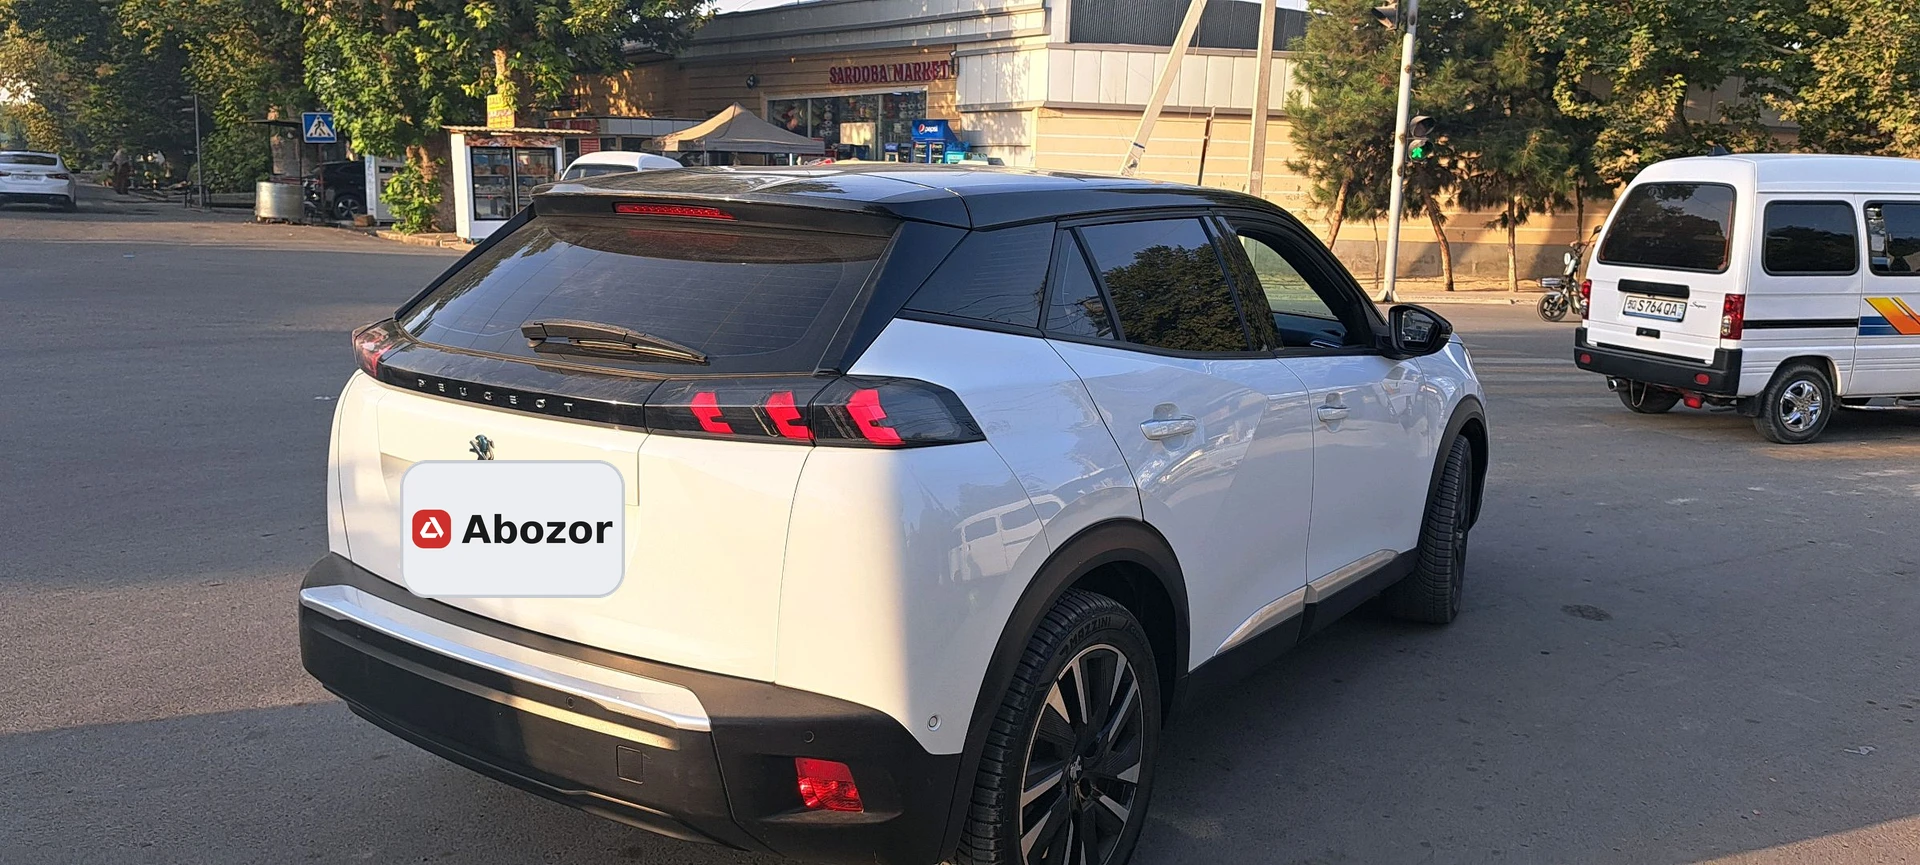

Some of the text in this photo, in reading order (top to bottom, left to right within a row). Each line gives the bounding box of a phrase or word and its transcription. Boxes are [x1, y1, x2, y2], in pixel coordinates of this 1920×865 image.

[829, 60, 949, 84] SARDOBA MARKET
[925, 125, 938, 133] pepsi
[417, 378, 574, 412] PEUGEOT
